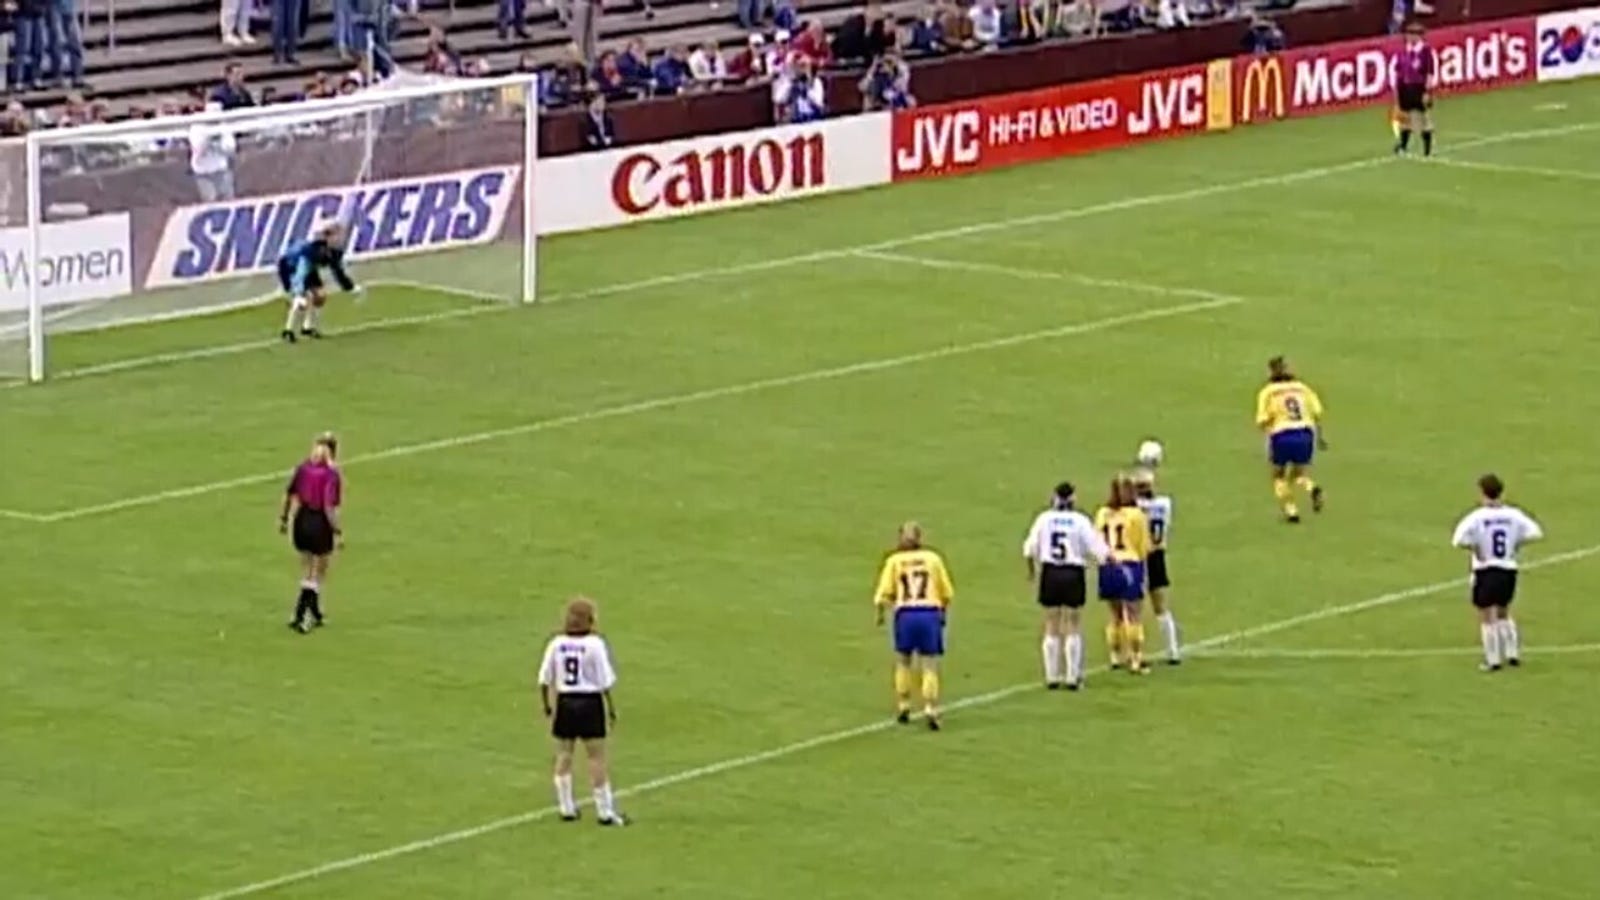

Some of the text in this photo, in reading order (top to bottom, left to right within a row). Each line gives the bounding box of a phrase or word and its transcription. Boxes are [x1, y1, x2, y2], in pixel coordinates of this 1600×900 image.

[1293, 31, 1527, 106] McDald's
[897, 110, 980, 171] JVC
[1127, 73, 1203, 134] JVC
[612, 133, 825, 214] Canon
[173, 172, 505, 278] SNICKERS
[1285, 396, 1302, 421] 9
[1050, 531, 1067, 561] 5
[1102, 523, 1126, 550] 11
[1492, 529, 1506, 558] 6
[900, 571, 929, 601] 17
[564, 656, 579, 686] 9
